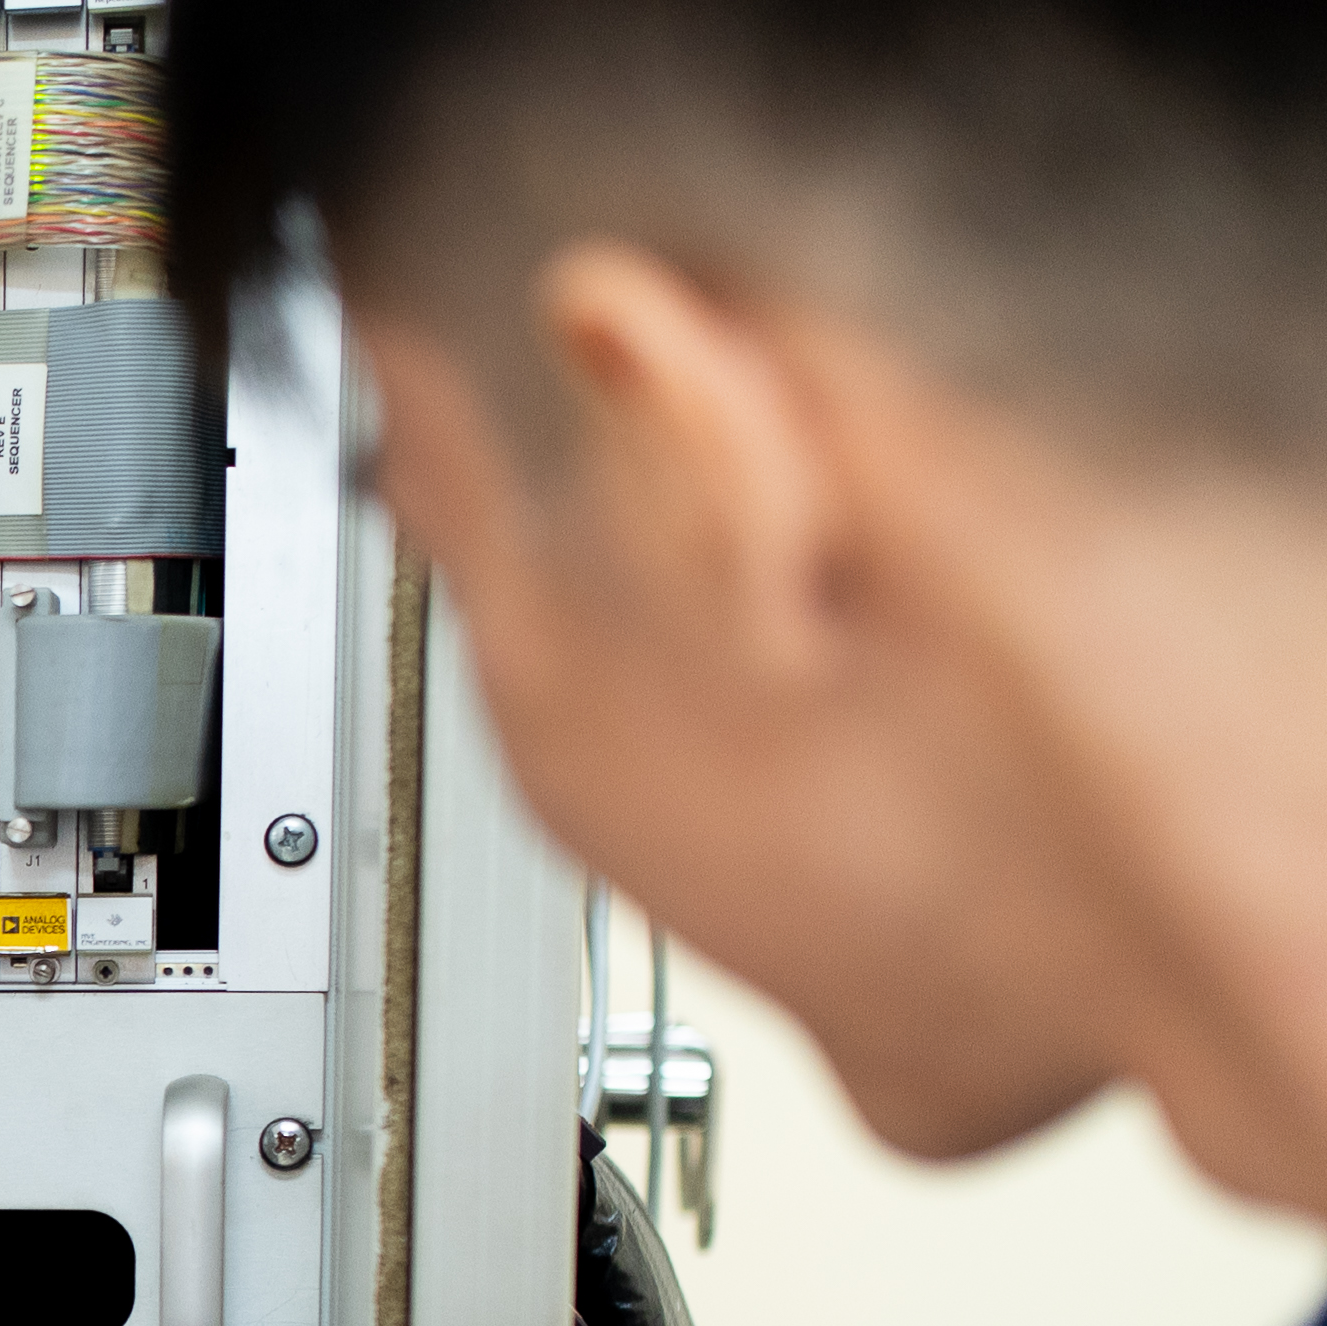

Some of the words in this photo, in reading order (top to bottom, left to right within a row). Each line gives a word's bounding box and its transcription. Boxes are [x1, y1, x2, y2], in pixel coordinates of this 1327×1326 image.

[4, 117, 17, 206] SEQUENCER
[10, 387, 23, 475] SEQUENCER
[22, 924, 65, 935] DEVICES
[23, 915, 65, 926] ANALOG
